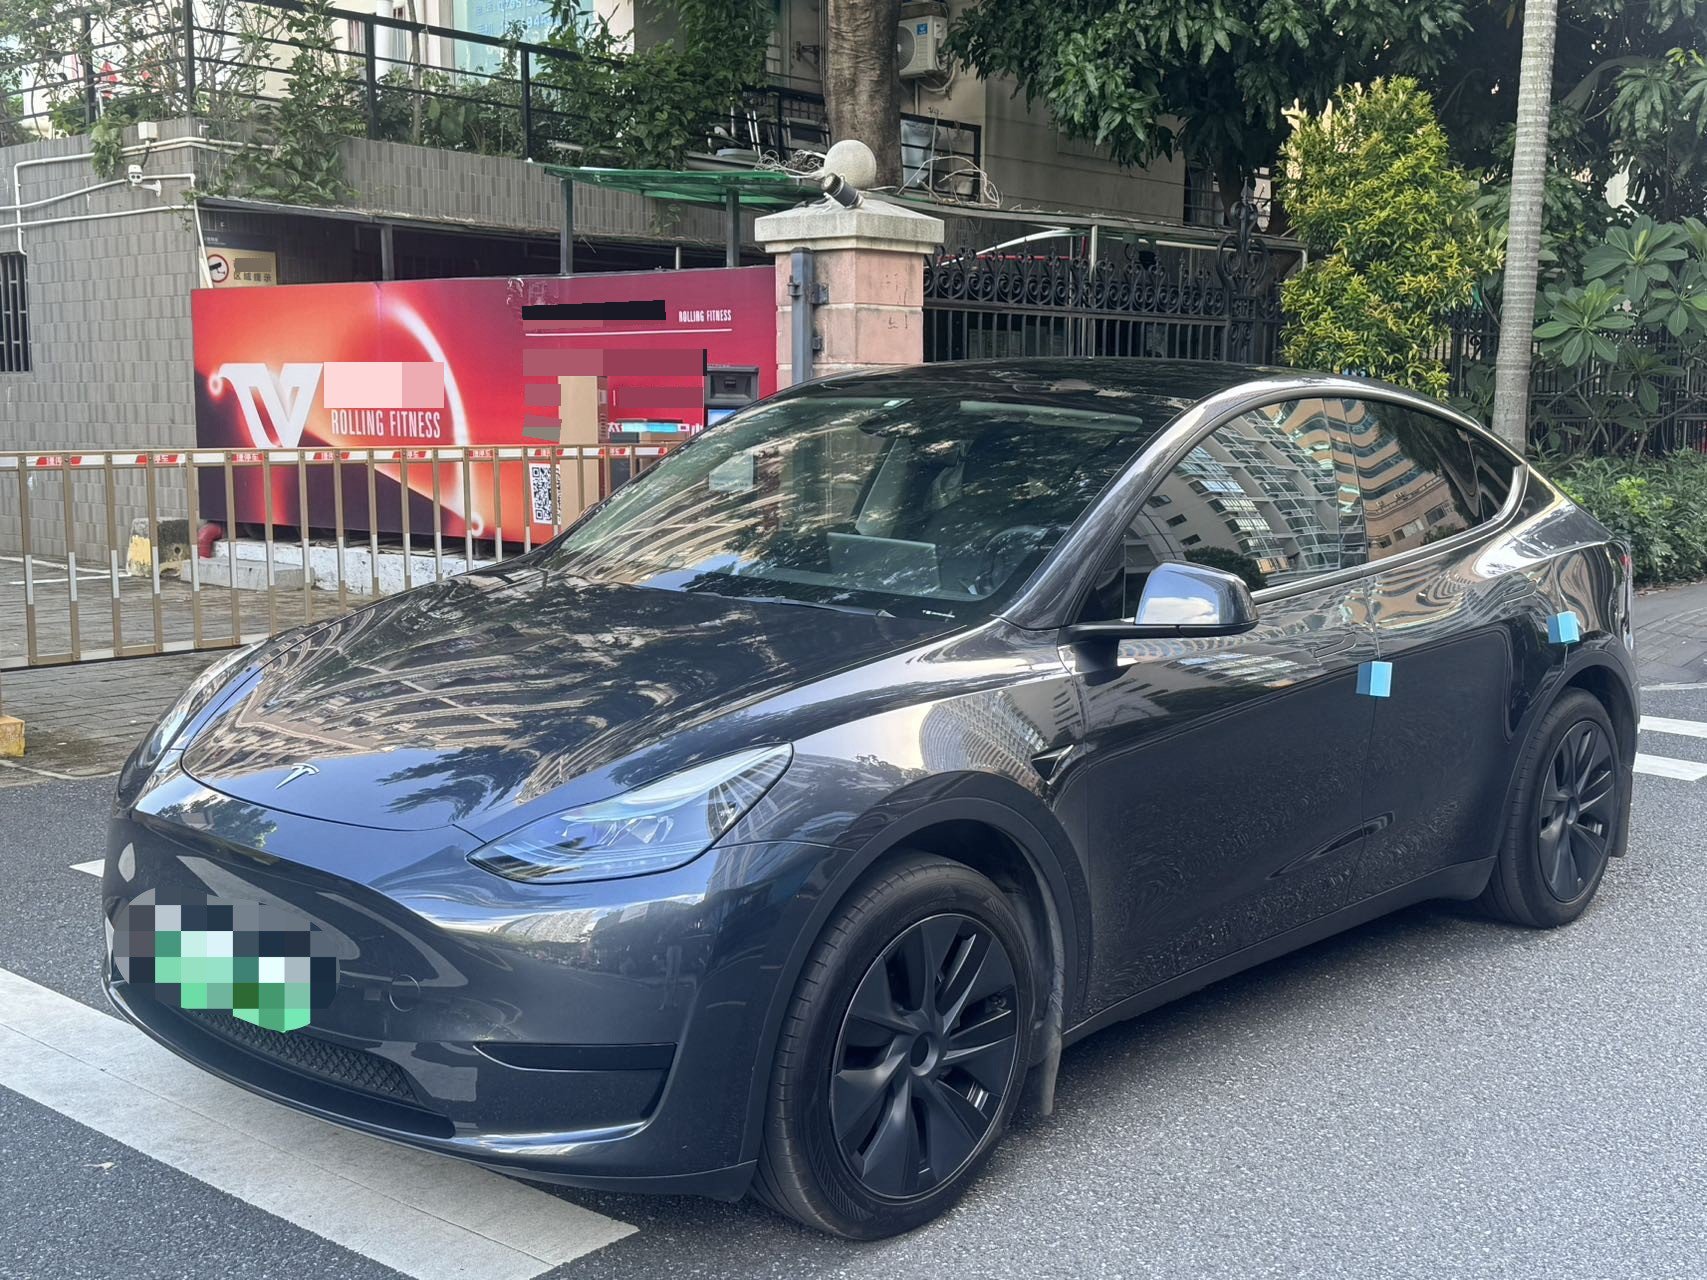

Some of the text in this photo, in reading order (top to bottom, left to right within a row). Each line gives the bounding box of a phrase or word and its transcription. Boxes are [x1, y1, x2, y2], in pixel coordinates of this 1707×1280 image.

[678, 309, 732, 323] ROLLING FITNESS
[331, 409, 441, 439] ROLLING FITNESS
